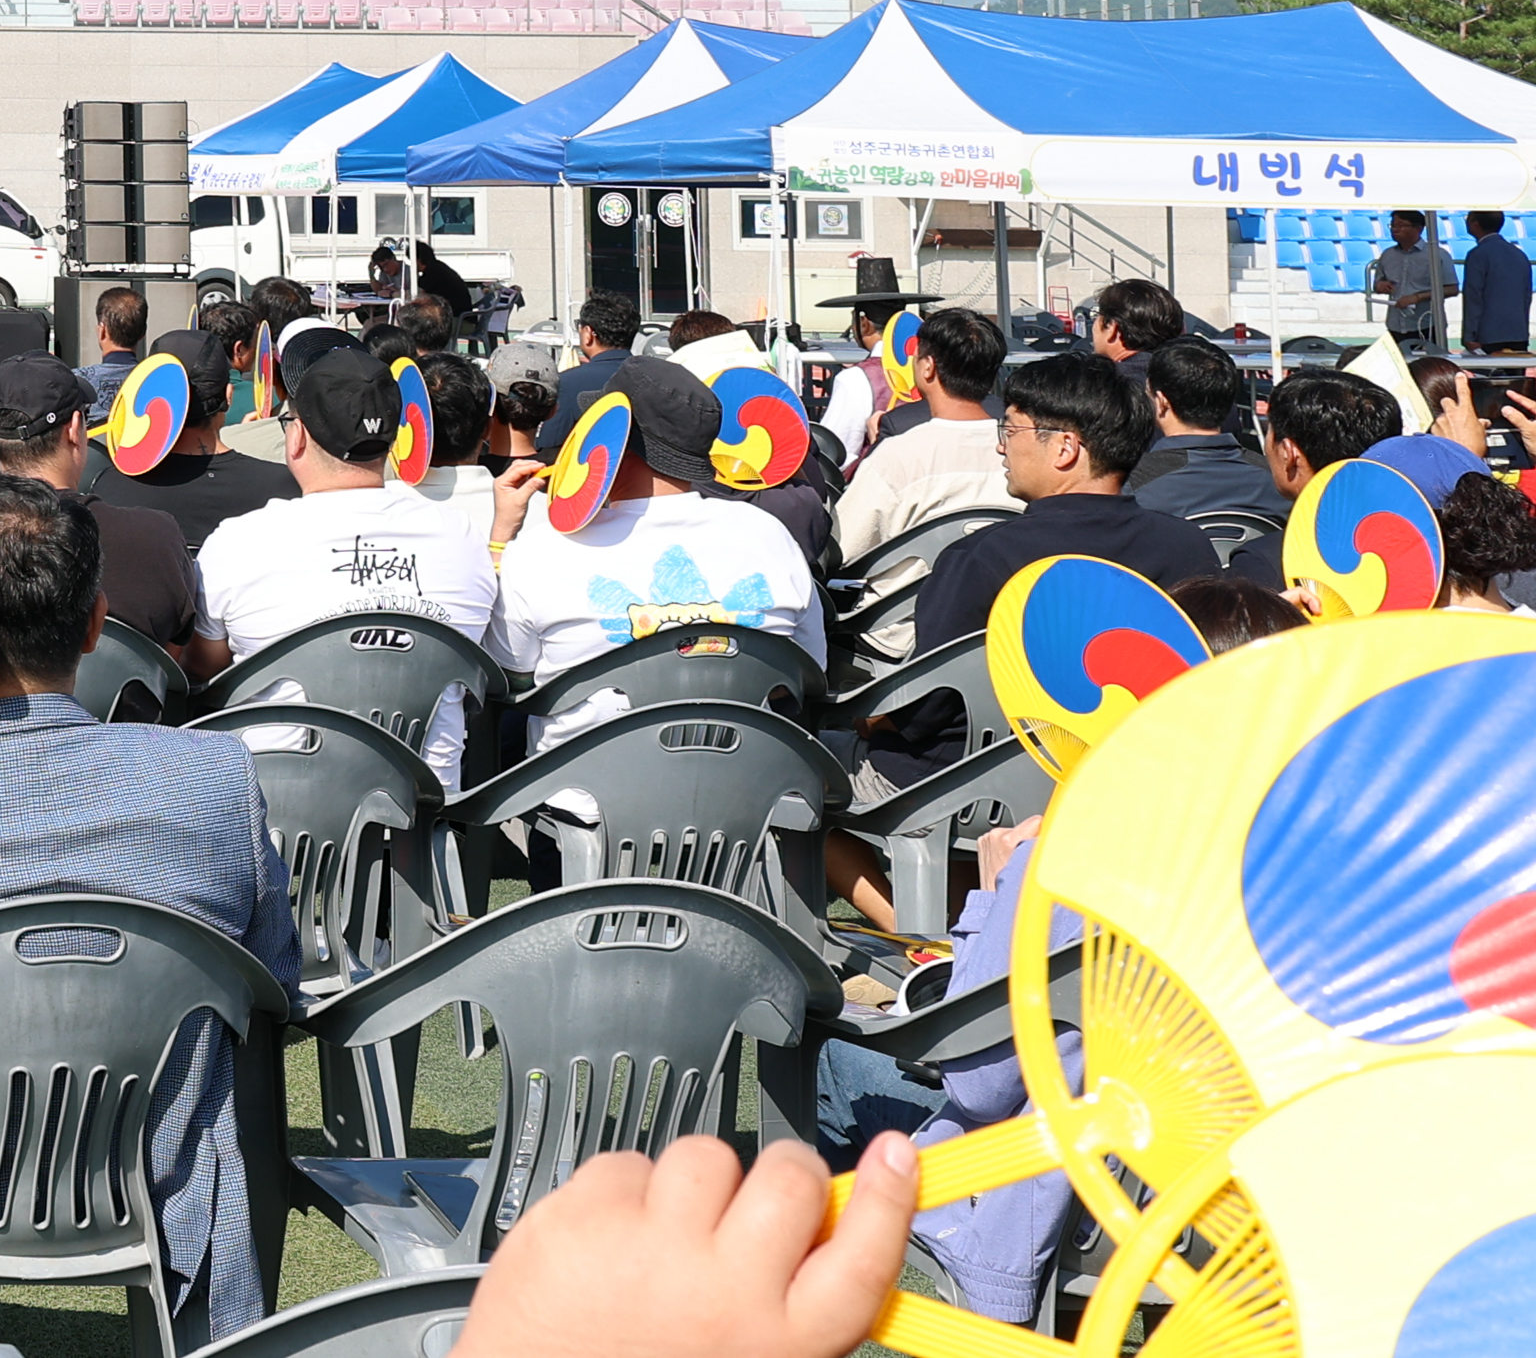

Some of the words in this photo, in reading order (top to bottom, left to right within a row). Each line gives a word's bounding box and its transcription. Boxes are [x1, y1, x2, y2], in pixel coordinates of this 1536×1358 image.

[848, 140, 995, 160] 성주군귀농귀촌연합회
[817, 164, 866, 185] 귀농인
[869, 164, 935, 187] 역량강화
[940, 168, 1020, 190] 한마음대회
[363, 417, 382, 434] W
